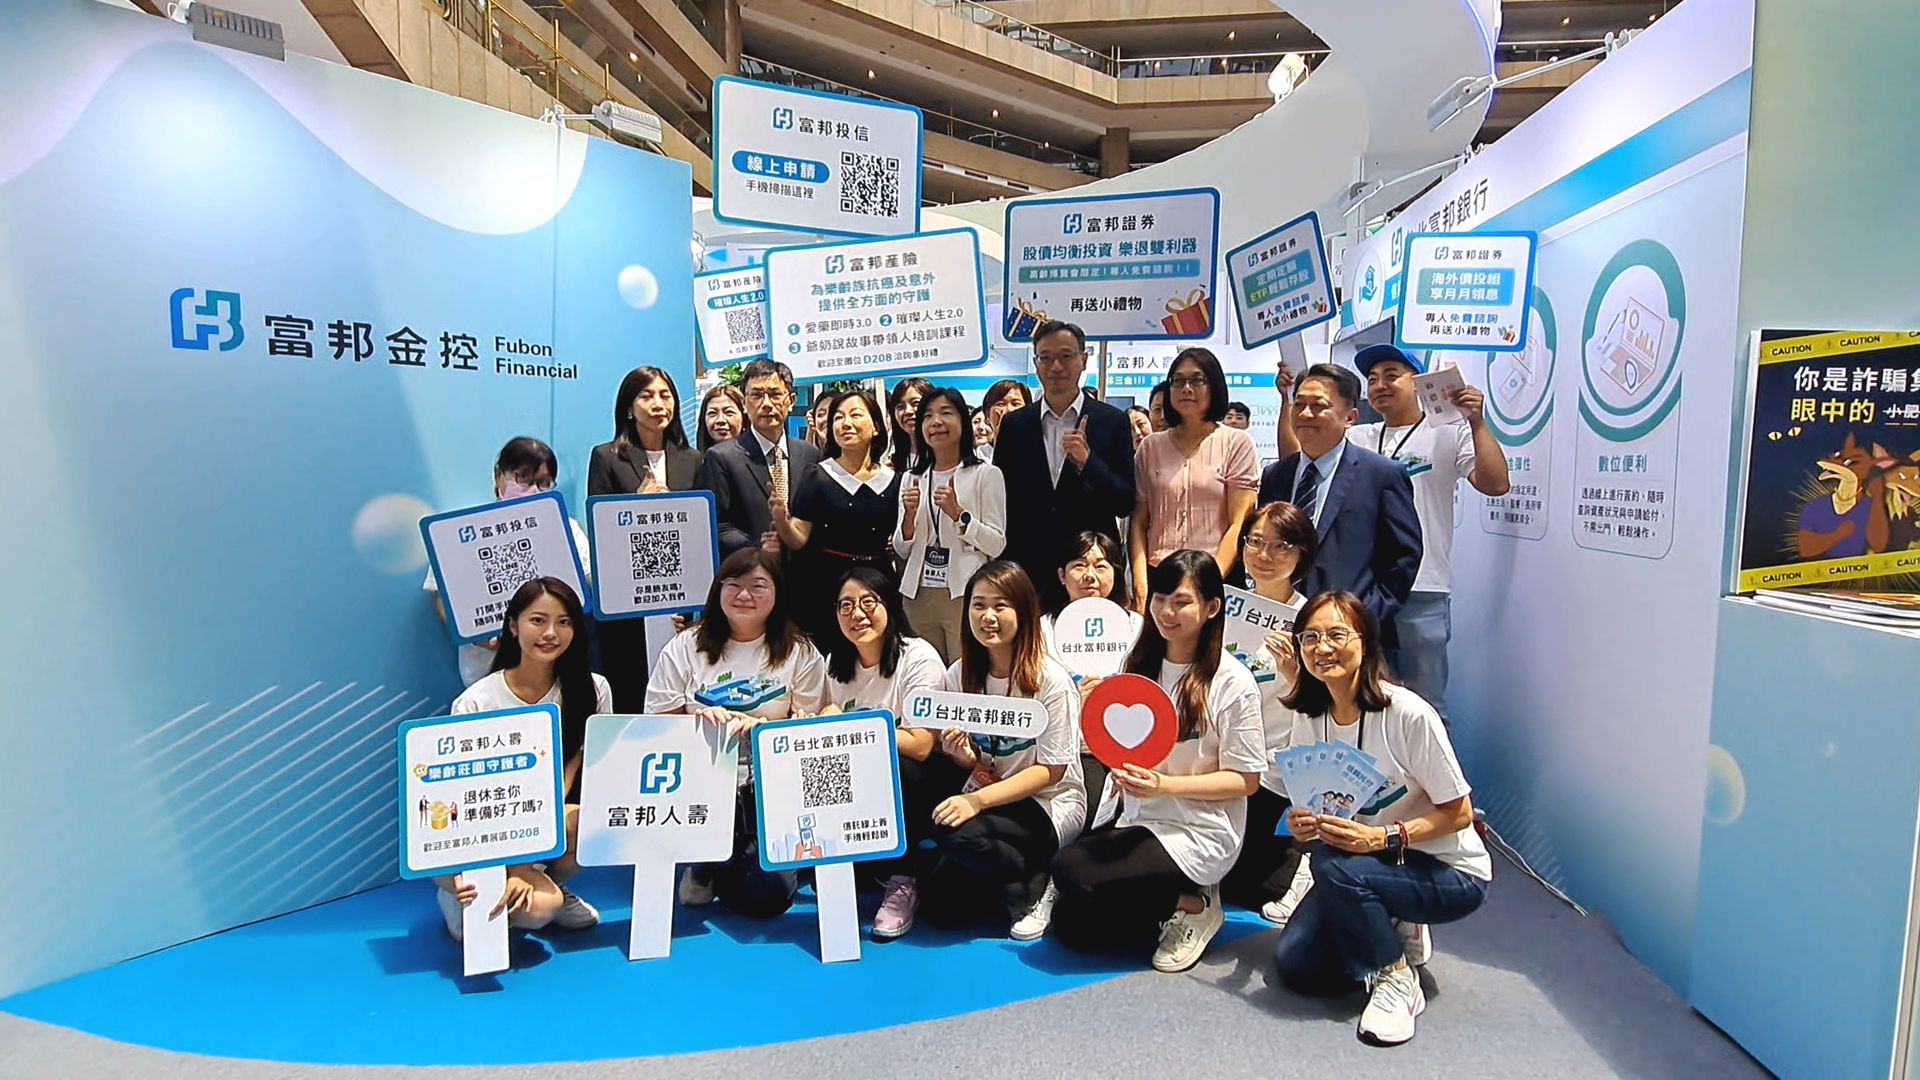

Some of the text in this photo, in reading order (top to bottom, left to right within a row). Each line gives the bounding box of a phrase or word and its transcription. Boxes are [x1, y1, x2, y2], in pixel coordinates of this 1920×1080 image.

[799, 117, 869, 142] 富邦投信
[746, 155, 816, 180] 線上申請
[746, 179, 815, 199] 手機掃描這裡
[1086, 214, 1156, 233] 富邦證券
[1023, 238, 1197, 262] 股價均衡投資 樂退雙利器
[1260, 238, 1297, 262] 富邦證券
[1452, 250, 1502, 260] 富邦證券
[849, 252, 918, 272] 富邦產險
[811, 271, 936, 297] 為樂齡族抗癌及意外
[818, 288, 930, 312] 提供全方面的守護
[1070, 296, 1142, 312] 再送小禮物
[1425, 313, 1498, 324] 專人免費諮詢
[805, 325, 966, 353] 爺奶說故事帶領人培訓課程
[1430, 325, 1491, 336] 再送小禮物
[264, 314, 480, 371] 富邦金控
[494, 336, 553, 358] Fubon
[1771, 344, 1812, 356] CAUTION
[1840, 335, 1881, 347] CAUTION
[863, 348, 892, 365] D208
[495, 358, 578, 380] Financial
[1790, 397, 1876, 423] 眼中的
[1598, 454, 1648, 473] 數位便利
[479, 516, 538, 539] 富邦投信
[636, 511, 688, 525] 富邦投信
[1762, 571, 1802, 583] CAUTION
[1829, 563, 1869, 575] CAUTION
[633, 592, 686, 604] 歡迎加入我們
[1062, 641, 1128, 653] 台北富邦銀行
[935, 704, 1033, 728] 台北富邦銀行
[459, 732, 522, 753] 富邦人壽
[793, 730, 877, 752] 台北富邦銀行
[428, 755, 529, 780] 樂齡莊園守護者
[463, 785, 521, 805] 退休金你
[607, 804, 709, 828] 富邦人壽
[509, 827, 540, 840] D208
